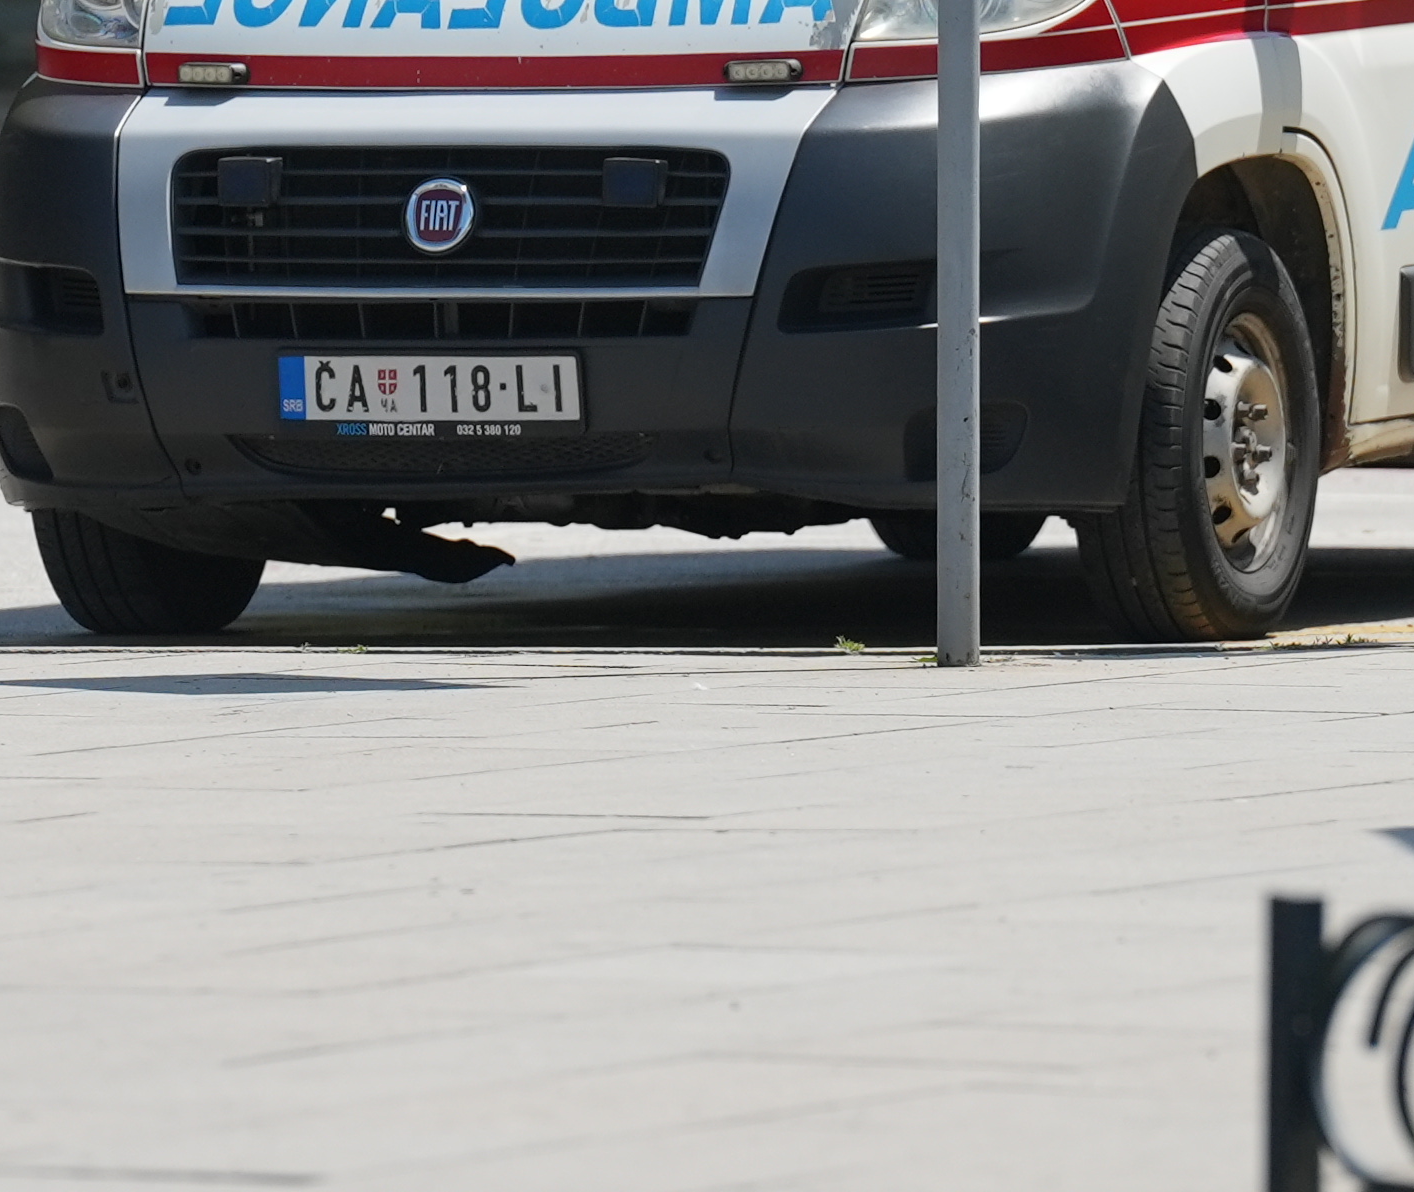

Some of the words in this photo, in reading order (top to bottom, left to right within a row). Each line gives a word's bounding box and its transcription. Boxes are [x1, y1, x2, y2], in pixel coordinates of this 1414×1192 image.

[420, 199, 460, 231] FIAT
[315, 360, 369, 413] ČA
[283, 399, 303, 412] SRB
[337, 424, 367, 436] XROSS
[369, 423, 395, 436] MOTO
[396, 423, 435, 436] CENTAR
[457, 424, 474, 436] 032
[476, 424, 482, 436] 5
[484, 424, 501, 436] 380
[504, 424, 521, 436] 120
